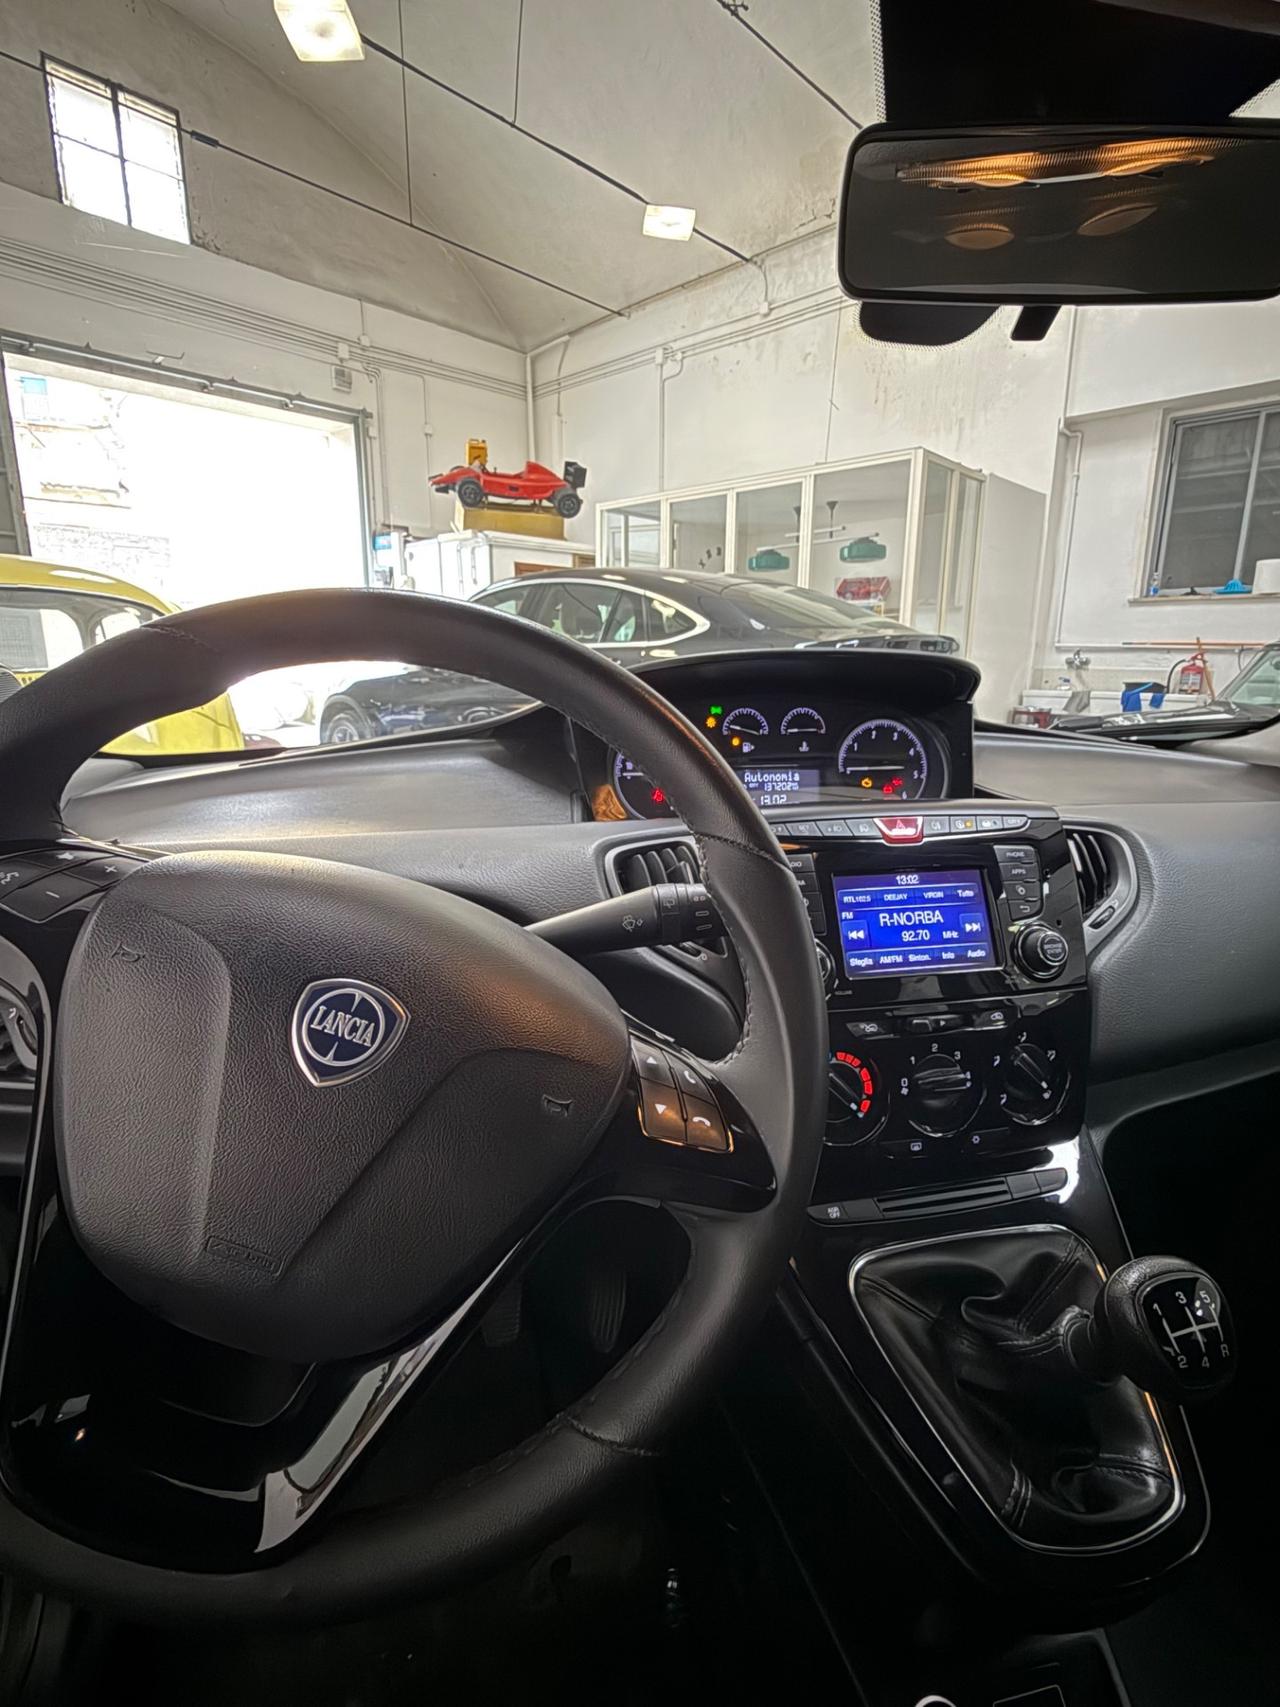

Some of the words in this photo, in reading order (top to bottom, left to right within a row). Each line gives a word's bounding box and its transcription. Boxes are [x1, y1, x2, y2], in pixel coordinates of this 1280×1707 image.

[909, 748, 915, 757] 4
[744, 770, 800, 783] Autonomia
[896, 874, 920, 885] 13:02
[883, 892, 908, 901] DEEJAY
[923, 891, 944, 899] VIRGIN
[841, 911, 854, 920] FM
[879, 910, 944, 927] R-NORBA
[901, 929, 930, 942] 92.70
[942, 931, 959, 940] MHz
[942, 951, 955, 960] Info
[967, 949, 986, 958] Audio
[879, 955, 903, 964] AM/FM
[310, 1004, 376, 1048] LANCIA
[931, 1043, 938, 1052] 2
[910, 1056, 916, 1065] 1
[954, 1051, 961, 1060] 3
[901, 1078, 908, 1087] 0
[1175, 1291, 1187, 1304] 3
[1200, 1290, 1210, 1303] 5
[1153, 1303, 1162, 1316] 1
[1220, 1344, 1229, 1357] R
[1177, 1355, 1188, 1368] 2
[1202, 1356, 1210, 1368] 4
